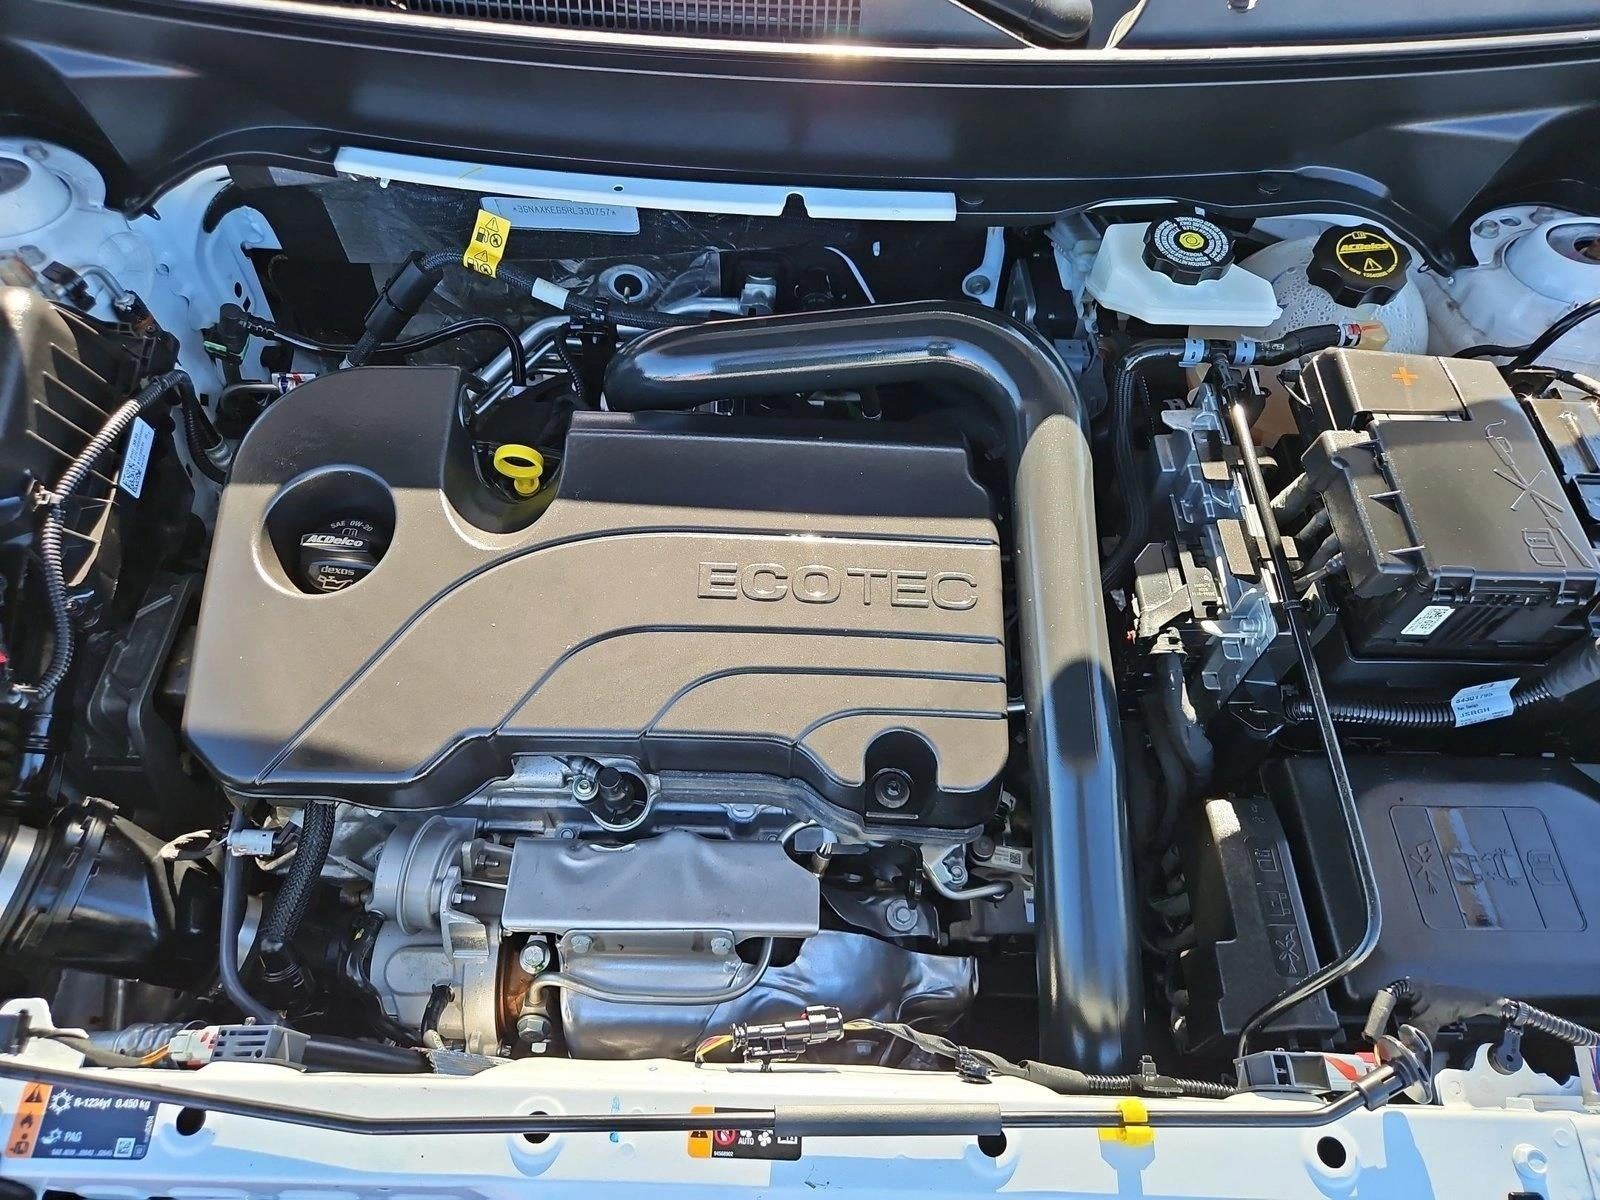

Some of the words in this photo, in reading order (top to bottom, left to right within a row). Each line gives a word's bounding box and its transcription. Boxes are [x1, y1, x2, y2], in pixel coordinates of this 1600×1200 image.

[330, 521, 346, 529] SAE
[349, 520, 374, 532] 0W-20
[306, 535, 364, 547] ACDelco
[320, 565, 355, 576] dexos
[697, 561, 979, 610] ECOTEC
[738, 1136, 755, 1146] AUTO
